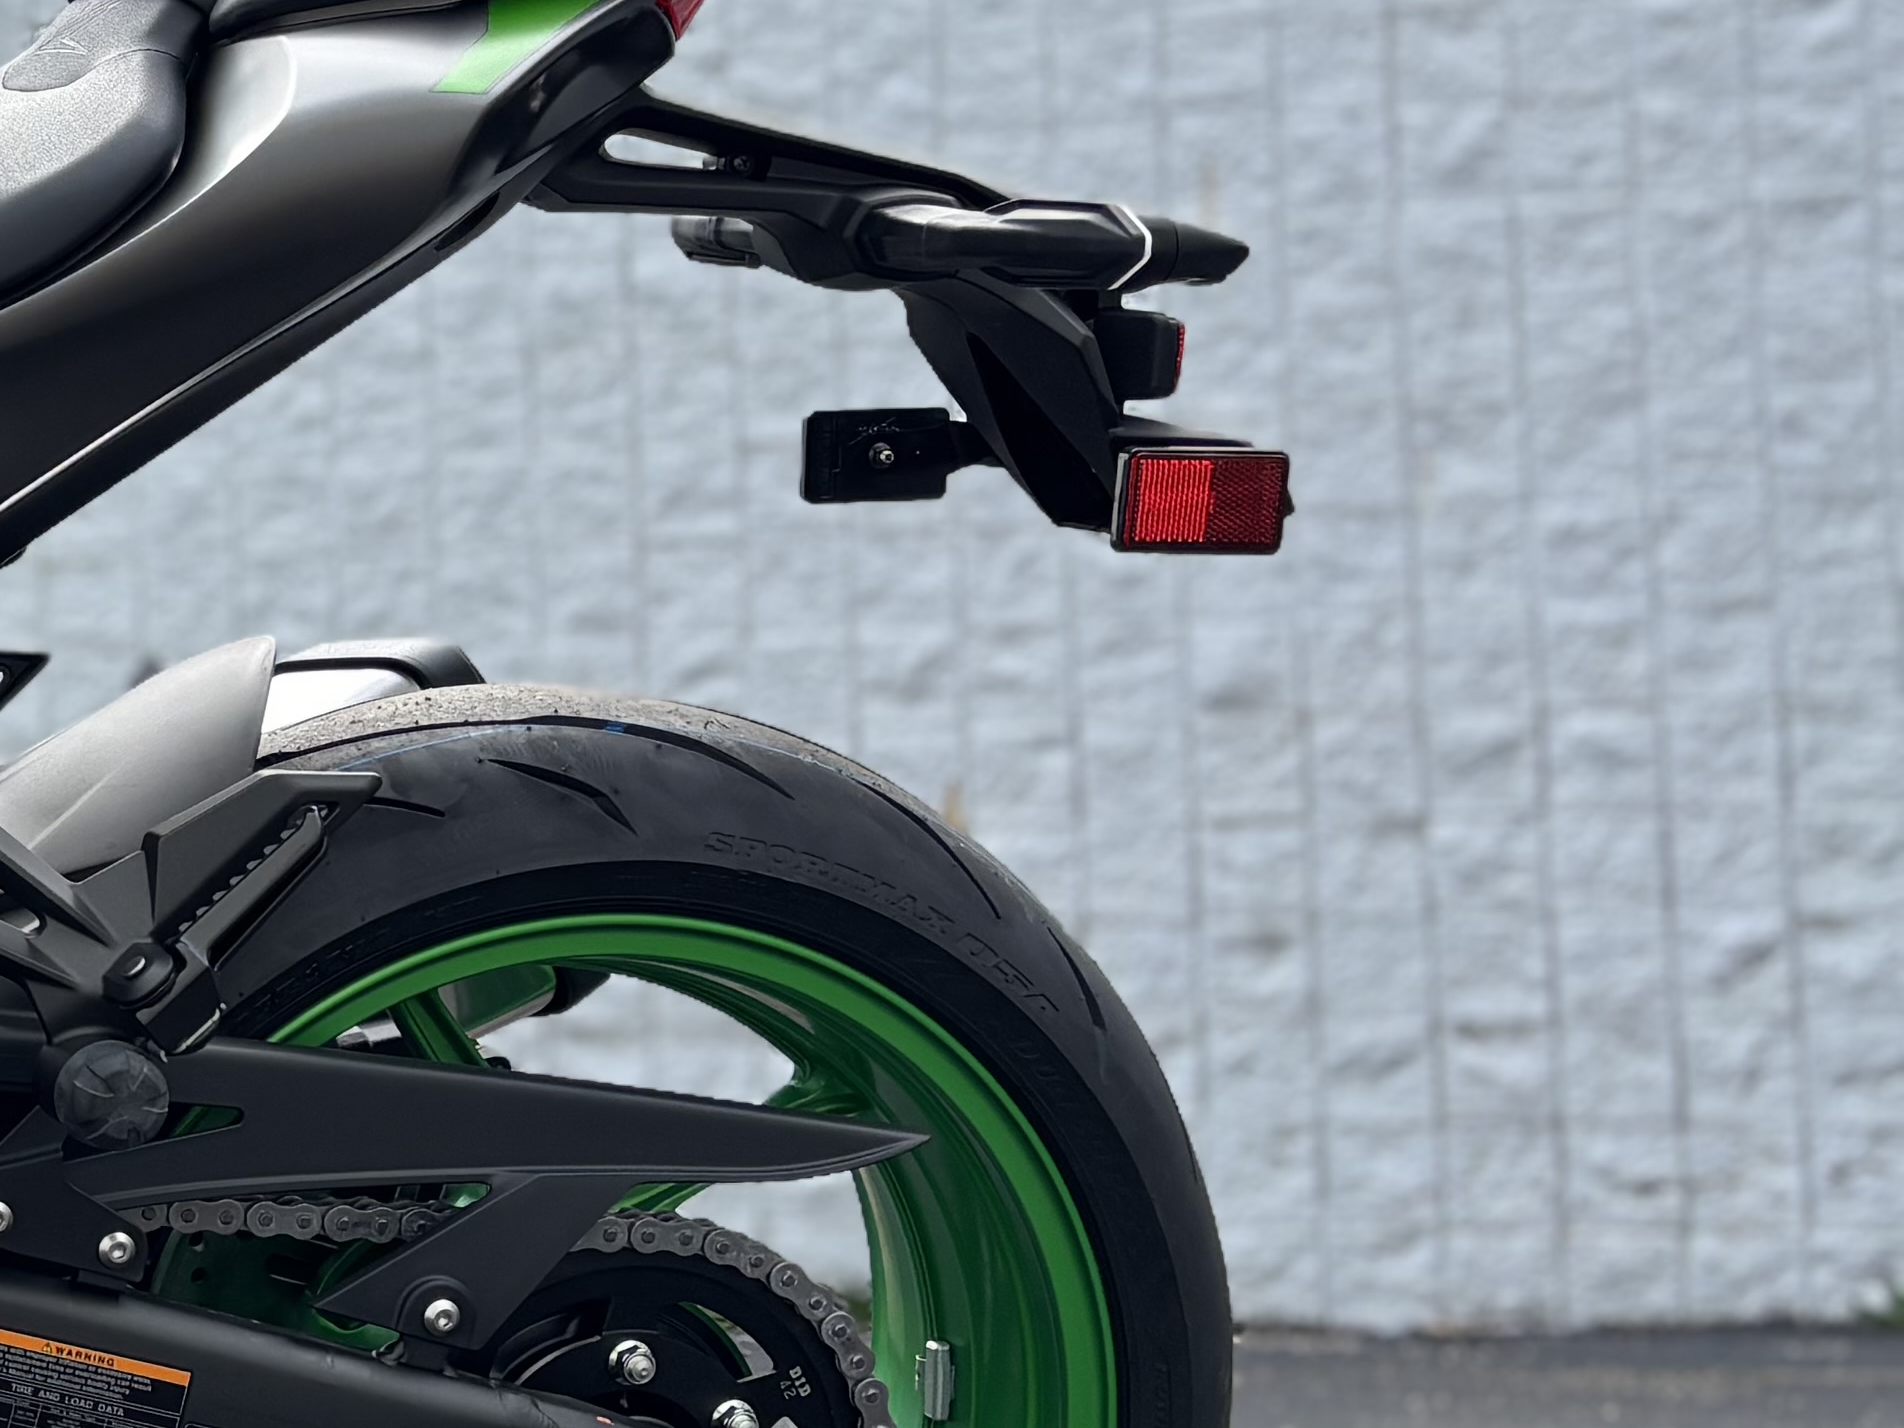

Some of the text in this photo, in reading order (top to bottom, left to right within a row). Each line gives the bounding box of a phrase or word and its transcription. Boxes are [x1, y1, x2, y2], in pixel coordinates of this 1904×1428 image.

[54, 1345, 116, 1367] WARNING
[63, 1395, 94, 1409] LOAD
[96, 1402, 126, 1416] DATA
